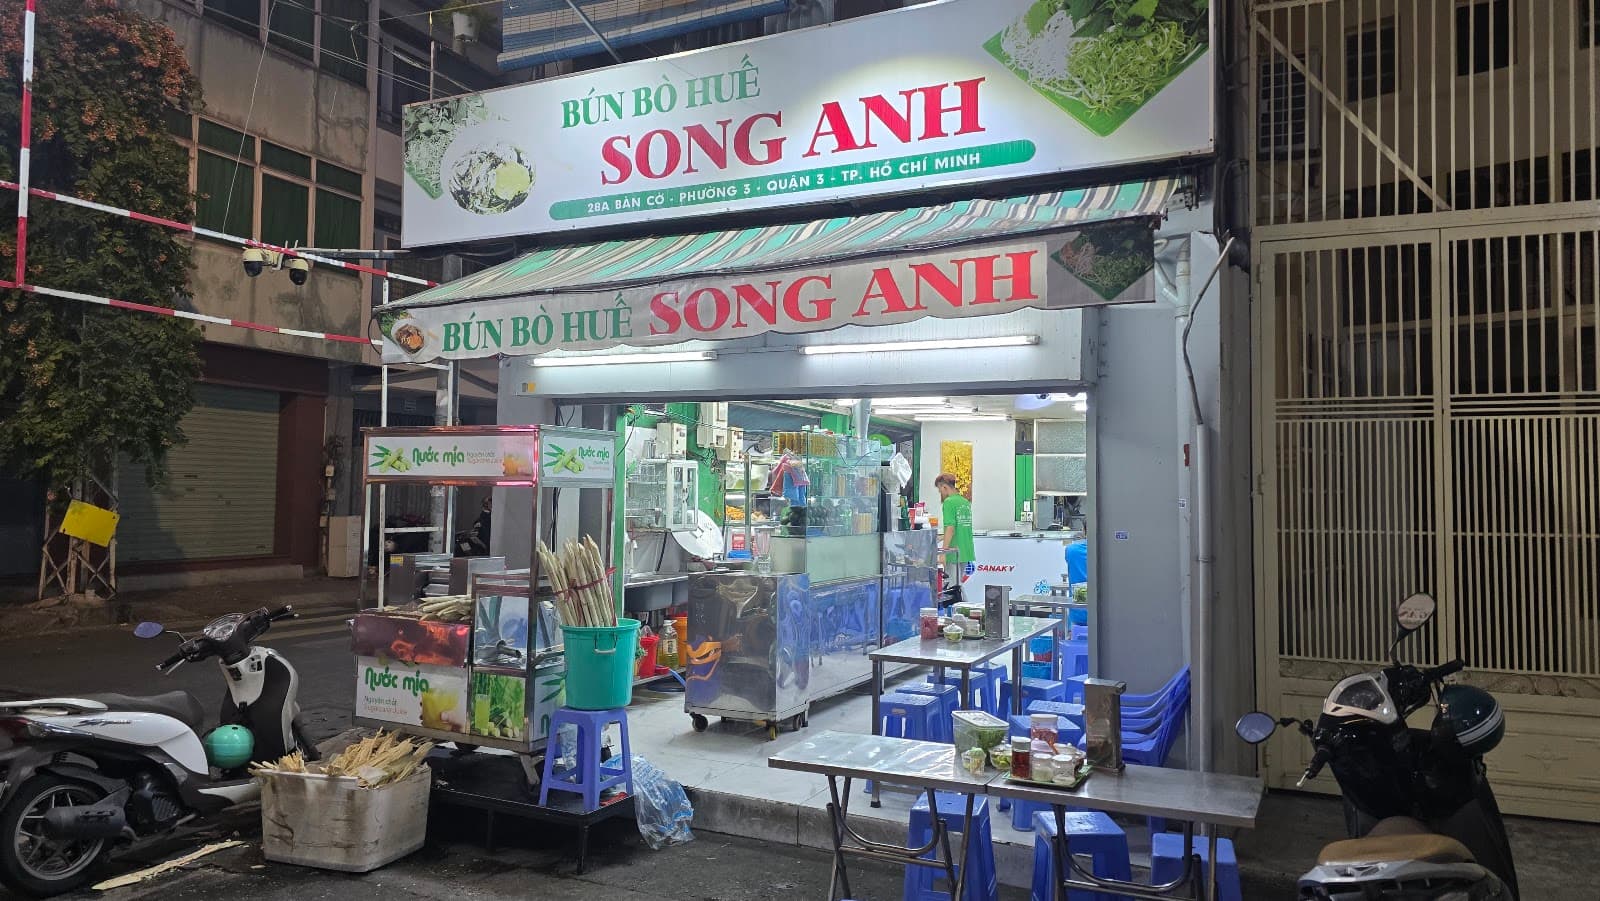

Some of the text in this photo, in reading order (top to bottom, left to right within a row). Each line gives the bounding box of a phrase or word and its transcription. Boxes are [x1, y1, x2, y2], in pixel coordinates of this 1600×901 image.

[561, 53, 761, 128] BÚN BÒ HUẾ
[601, 76, 986, 185] SONG ANH
[587, 202, 609, 213] 28A
[743, 183, 751, 195] 3
[767, 175, 810, 192] QUẬN
[817, 174, 825, 185] 3
[841, 169, 863, 182] TP.
[899, 156, 928, 174] CHÍ
[934, 152, 981, 170] MINH
[442, 250, 1039, 352] BÚN BÒ HUẾ SONG ANH
[977, 564, 1015, 572] SANAKY
[402, 669, 430, 697] mía
